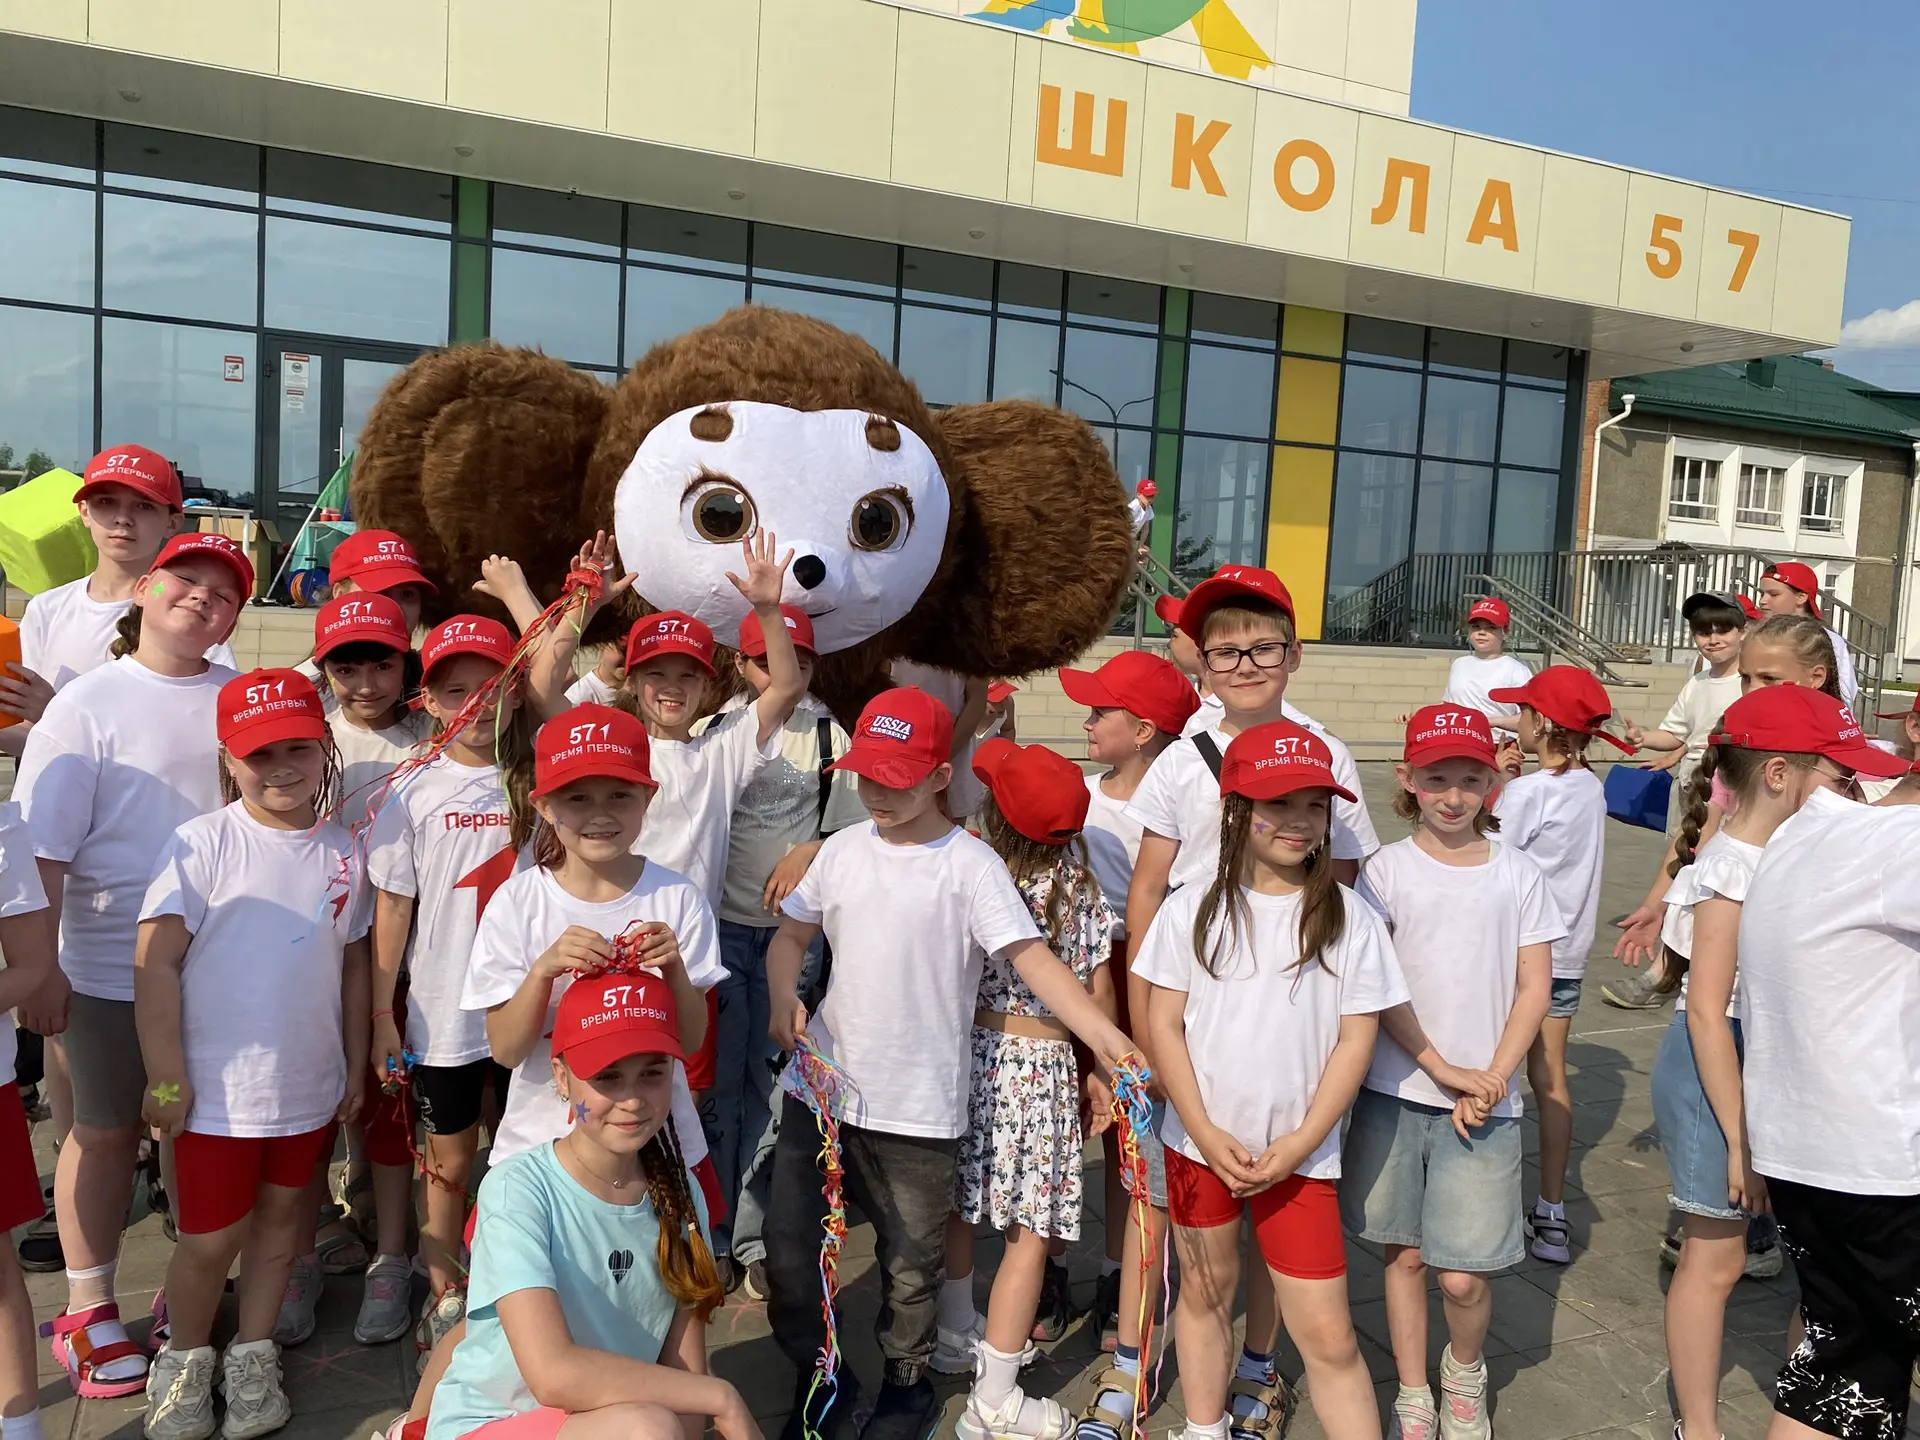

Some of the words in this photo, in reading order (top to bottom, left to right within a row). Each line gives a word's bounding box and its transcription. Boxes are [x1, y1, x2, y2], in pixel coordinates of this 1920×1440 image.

[1036, 84, 1519, 251] ШКОЛА
[1645, 214, 1760, 292] 57
[117, 466, 155, 482] ПЕРВЫХ
[363, 554, 391, 564] ВРЕМЯ
[324, 618, 351, 635] ВРЕМЯ
[354, 616, 392, 625] ПЕРВЫХ
[456, 635, 496, 645] ПЕРВЫХ
[641, 634, 669, 646] ВРЕМЯ
[233, 705, 263, 723] ВРЕМЯ
[266, 699, 307, 713] ПЕРВЫХ
[1416, 727, 1447, 742] ВРЕМЯ
[551, 745, 583, 765] ВРЕМЯ
[587, 744, 633, 756] ПЕРВЫХ
[1255, 756, 1290, 771] ВРЕМЯ
[1293, 755, 1329, 770] ПЕРВЫ
[581, 1009, 620, 1029] ВРЕМЯ
[624, 1008, 667, 1022] ПЕРВЫХ
